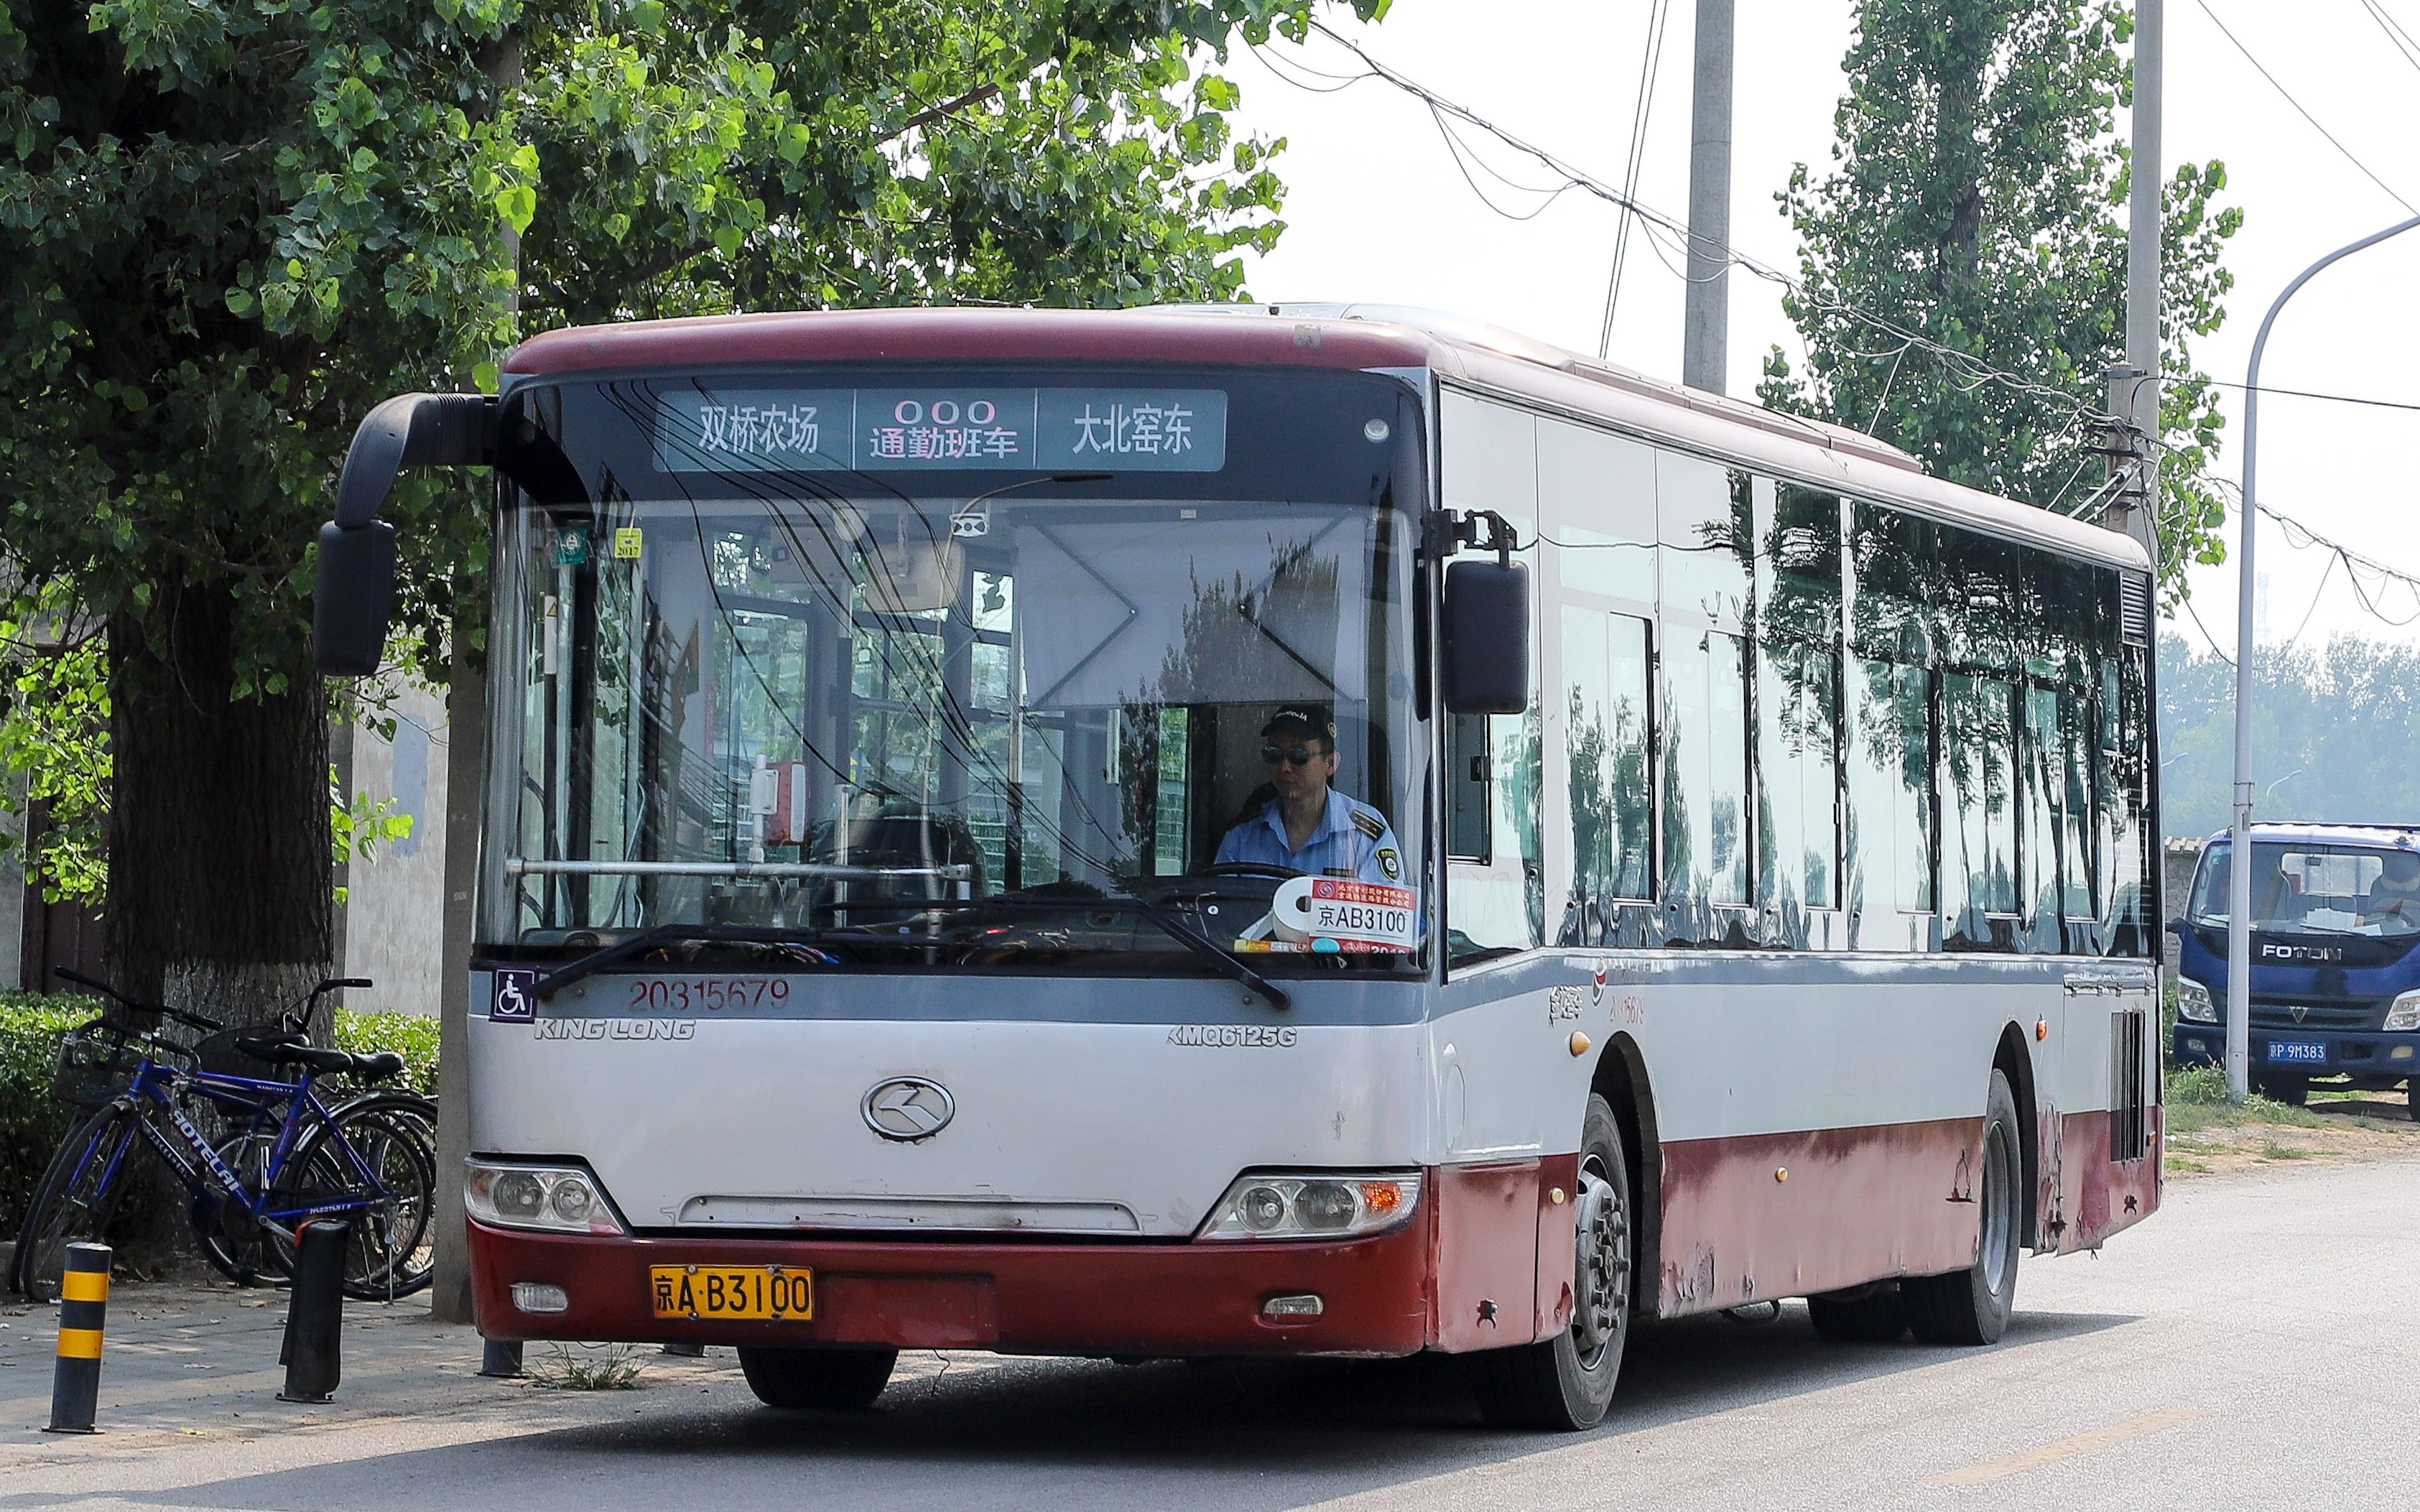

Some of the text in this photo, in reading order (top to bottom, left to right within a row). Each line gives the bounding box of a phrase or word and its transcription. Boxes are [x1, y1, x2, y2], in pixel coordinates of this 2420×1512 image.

[698, 403, 819, 454] 双桥农场
[870, 426, 1019, 460] 通勤班车
[1072, 402, 1193, 455] 大北窑东
[1318, 905, 1406, 933] 京AB3100
[2262, 944, 2342, 960] FOTON
[629, 978, 789, 1012] 20315679
[534, 1018, 696, 1040] KING LONG
[1168, 1024, 1298, 1047] KMQ6125G
